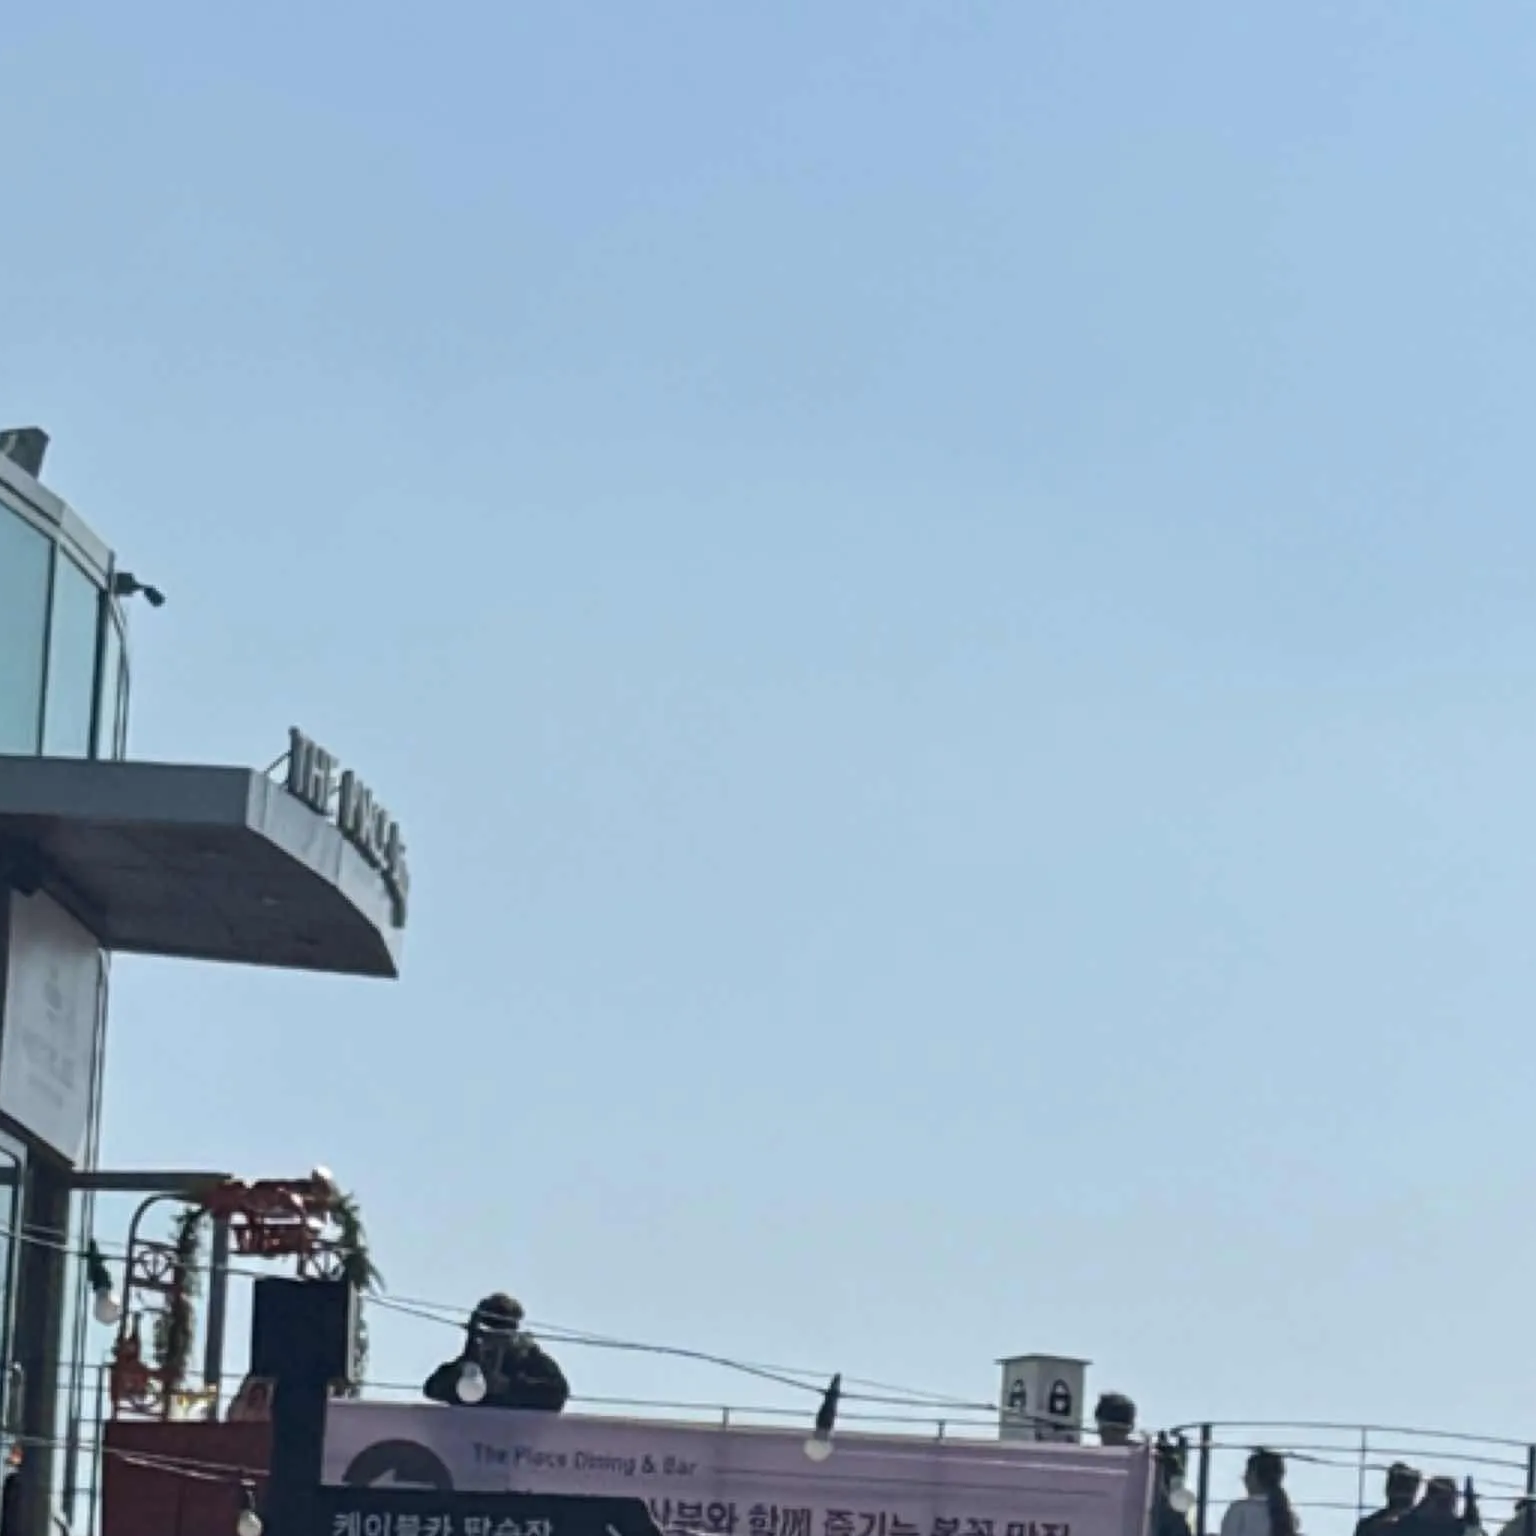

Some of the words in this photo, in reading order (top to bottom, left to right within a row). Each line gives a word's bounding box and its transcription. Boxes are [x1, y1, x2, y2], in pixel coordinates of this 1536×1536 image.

[473, 1442, 507, 1465] The
[514, 1446, 568, 1469] Place
[575, 1451, 635, 1477] Dining
[642, 1453, 657, 1474] &
[664, 1456, 697, 1477] Bar
